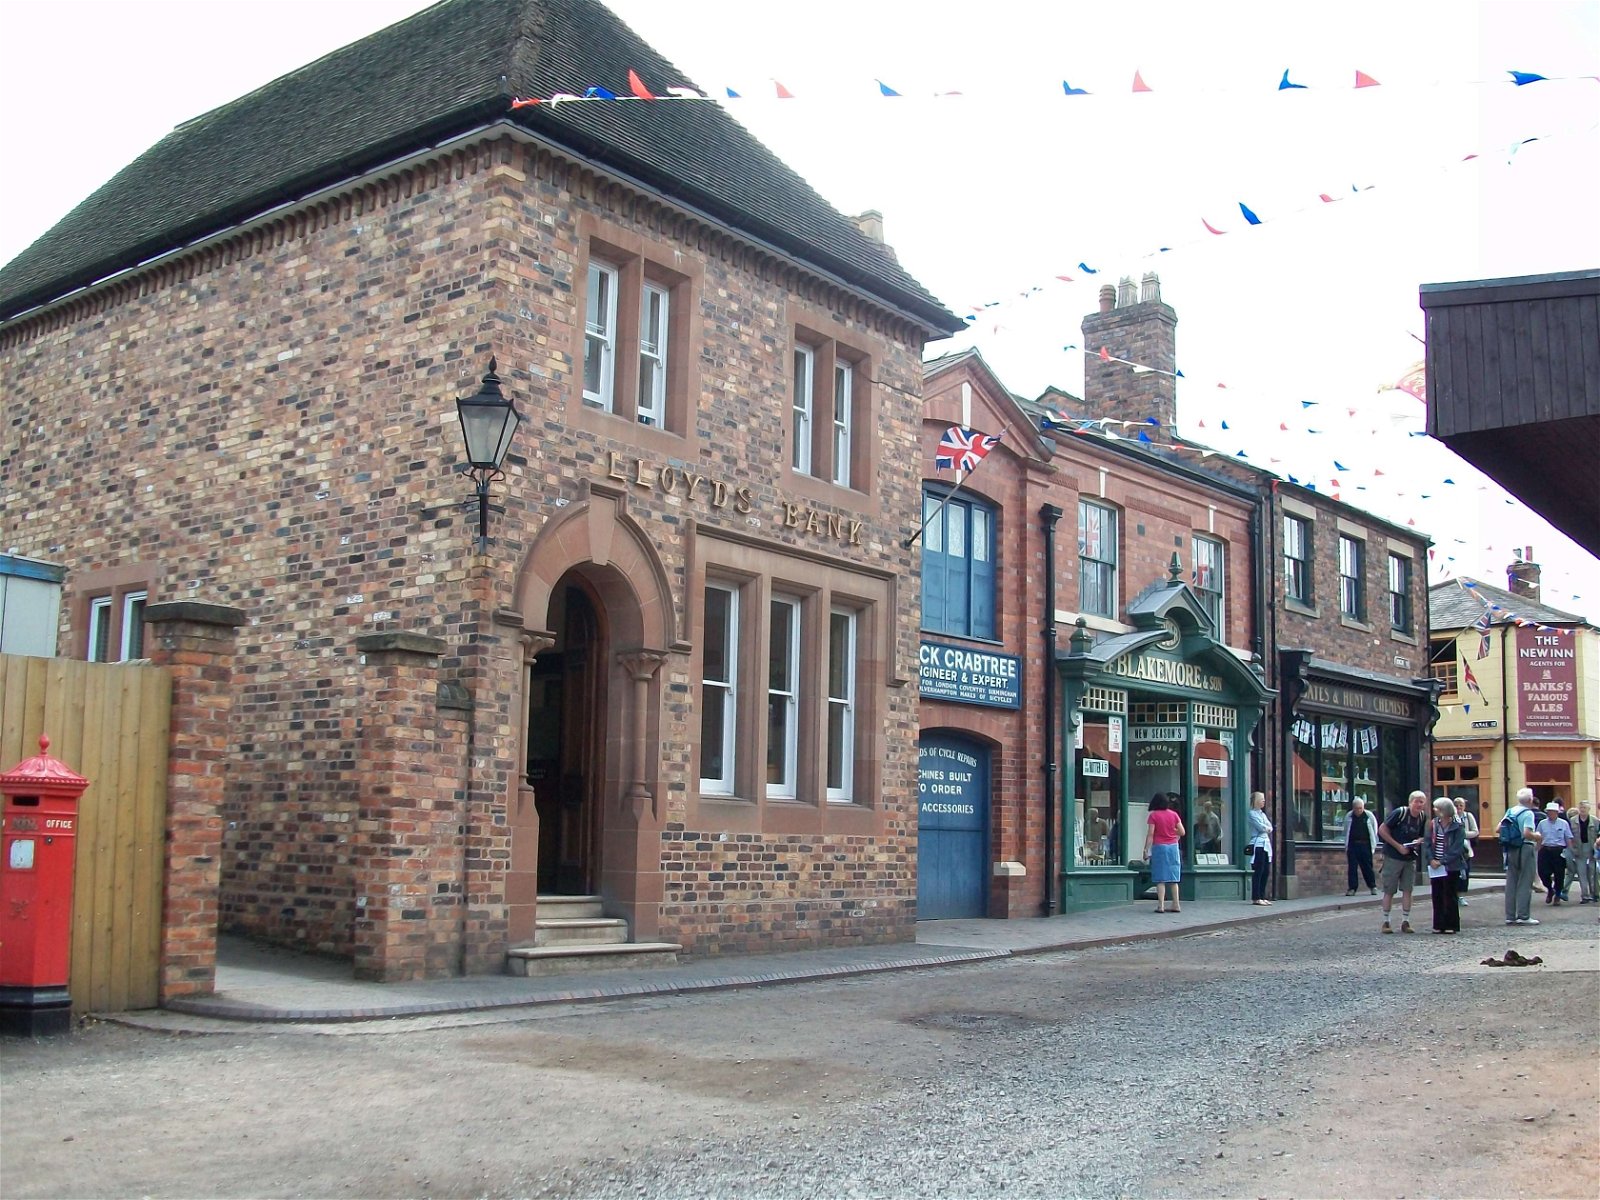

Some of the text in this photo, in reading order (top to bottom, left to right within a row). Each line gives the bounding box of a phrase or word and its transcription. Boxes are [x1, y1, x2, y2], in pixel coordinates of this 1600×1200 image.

[608, 451, 863, 545] LLOYDS BANK
[1534, 635, 1559, 646] THE
[1520, 648, 1574, 658] NEW INN
[944, 649, 1017, 678] CRABTREE
[961, 672, 969, 683] &
[1116, 654, 1202, 689] BLAKEMORE
[1203, 677, 1209, 690] &
[1209, 676, 1223, 692] SON
[921, 679, 933, 687] FOR
[1523, 681, 1573, 691] BANKS'S
[1528, 693, 1569, 701] FAMOUS
[1343, 690, 1364, 709] HUNT
[1373, 696, 1410, 717] CHEMISTS
[1532, 703, 1564, 712] ALES
[1134, 728, 1148, 739] NEW
[929, 747, 937, 757] OF
[938, 747, 956, 760] CYCLE
[957, 752, 978, 768] REPAIRS
[1135, 759, 1178, 767] CHOCOLATE
[949, 771, 973, 782] BUILT
[931, 784, 962, 795] ORDER
[921, 803, 974, 814] ACCESSORIES
[46, 819, 73, 829] OFFICE
